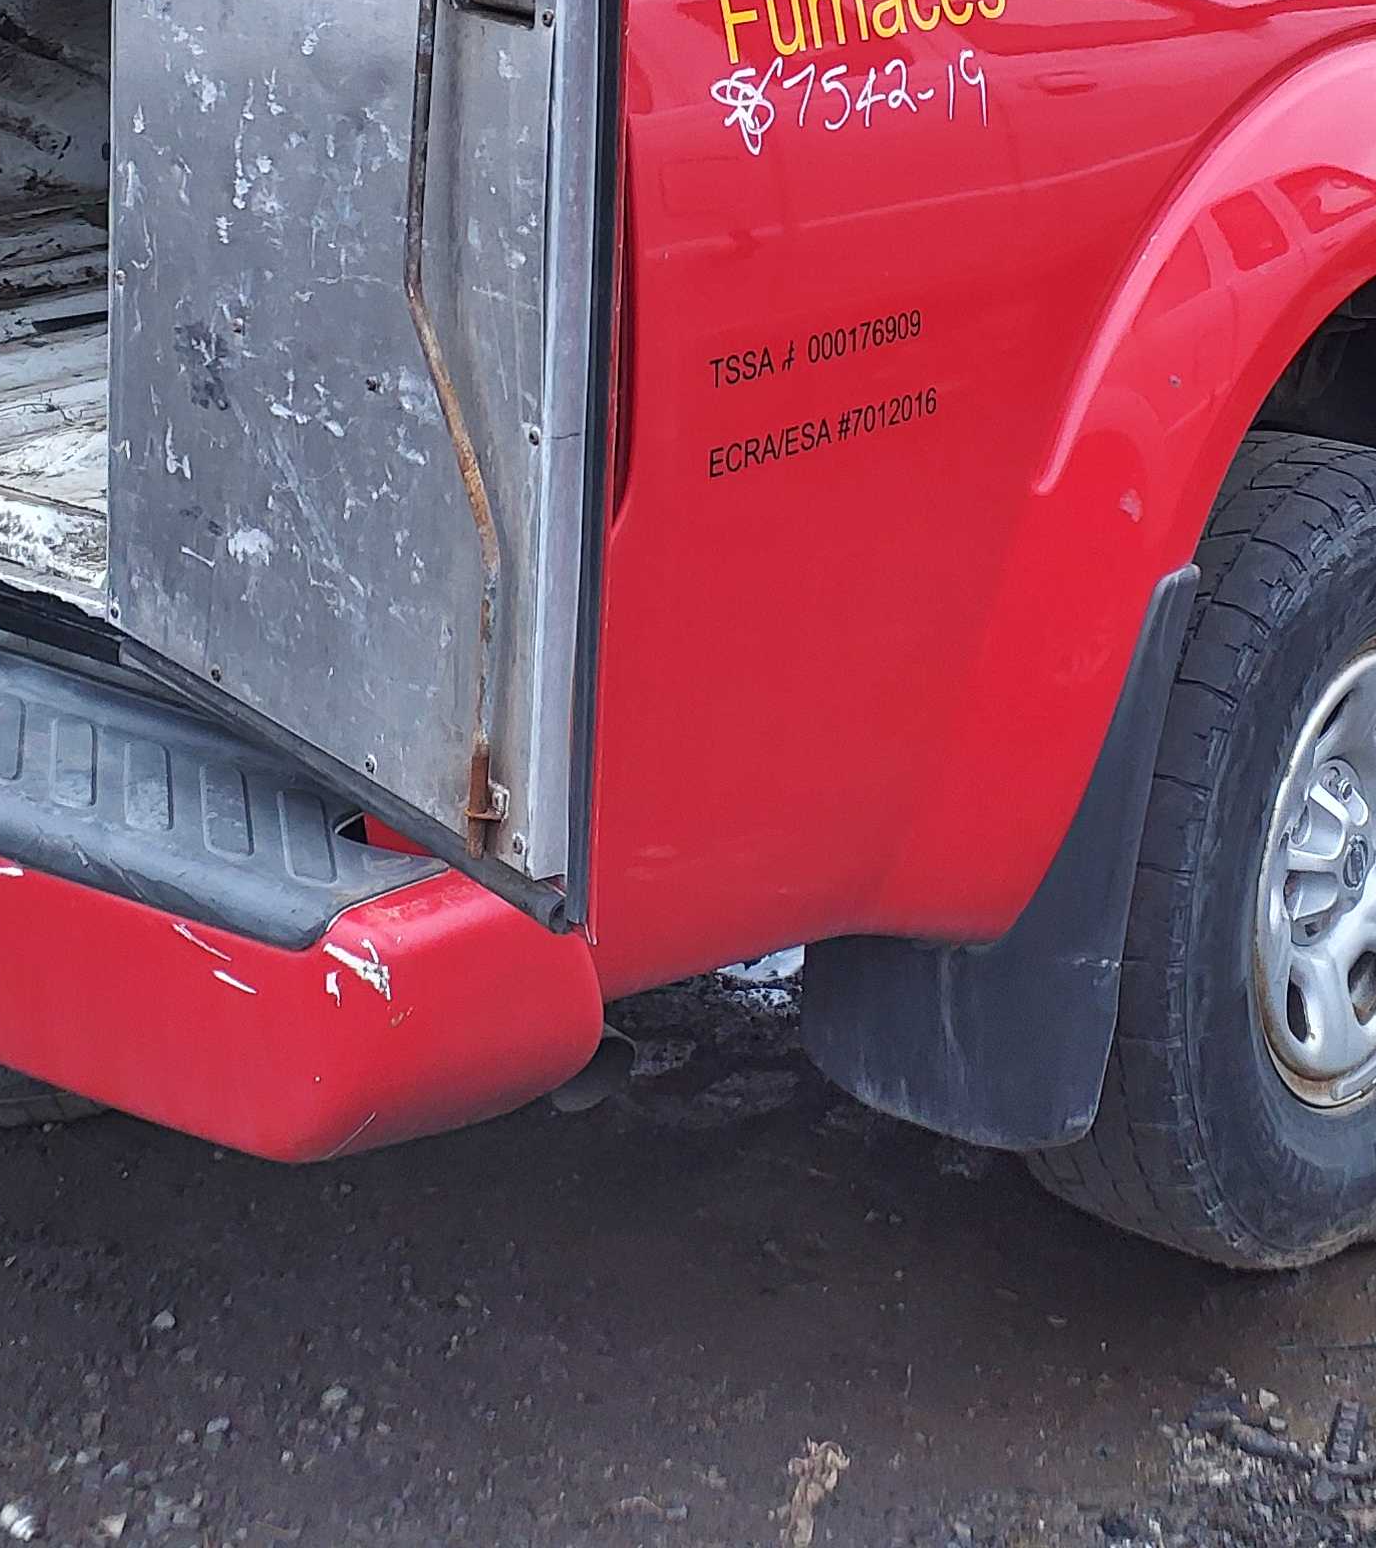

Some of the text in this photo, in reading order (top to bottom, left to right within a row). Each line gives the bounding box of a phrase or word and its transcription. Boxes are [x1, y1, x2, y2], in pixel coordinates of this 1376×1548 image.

[708, 345, 776, 389] TSSA
[807, 308, 922, 364] 000176909
[708, 386, 938, 479] ECRA/ESA #7012016
